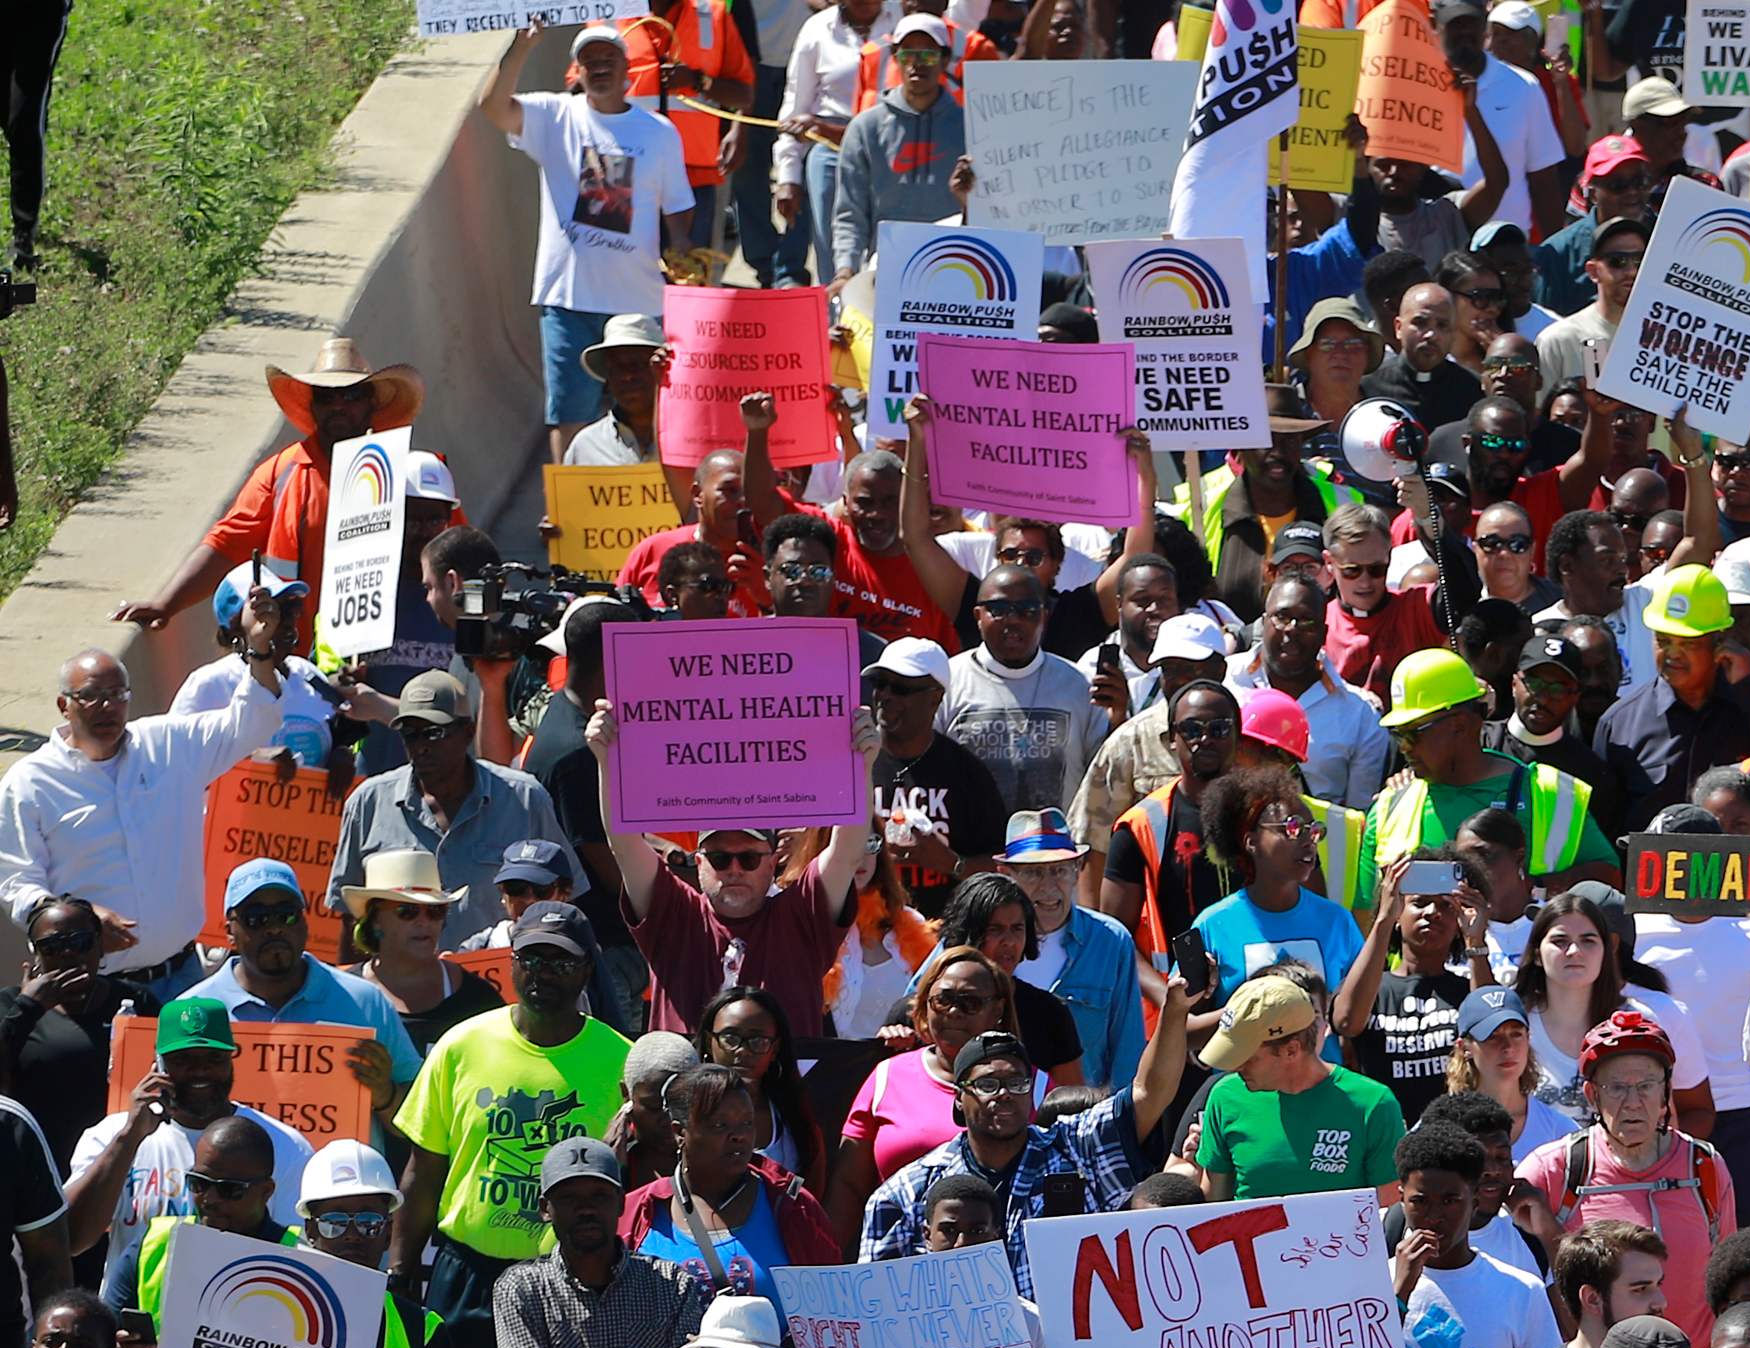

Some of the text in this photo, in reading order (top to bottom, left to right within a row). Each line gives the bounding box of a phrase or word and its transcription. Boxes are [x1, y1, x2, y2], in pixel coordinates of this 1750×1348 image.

[572, 5, 589, 20] TO
[1709, 22, 1741, 39] WE
[696, 320, 766, 338] WE NEED
[909, 315, 1008, 327] COALITION
[1650, 302, 1706, 333] STOP
[1134, 326, 1226, 336] COALITION
[764, 353, 802, 370] FOR
[1161, 352, 1239, 363] THE BORDER
[971, 368, 1077, 395] WE NEED
[1166, 366, 1230, 386] NEED
[1636, 351, 1734, 397] SAVE THE
[1145, 388, 1224, 411] SAFE
[1631, 367, 1730, 414] CHILDREN
[936, 402, 1122, 434] MENTAL HEALTH
[969, 441, 1088, 470] FACILITIES
[589, 486, 631, 507] WE
[336, 570, 383, 595] WE NEED
[332, 591, 382, 628] JOBS
[669, 653, 793, 677] WE NEED
[622, 696, 844, 722] MENTAL HEALTH
[665, 741, 807, 764] FACILITIES
[237, 777, 300, 810] STOP
[657, 793, 817, 807] Faith Community of Saint Sabina
[1386, 1030, 1455, 1053] DESERVE
[253, 1045, 334, 1075] THIS
[1317, 1129, 1351, 1144] TOP
[1313, 1143, 1348, 1158] BOX
[1310, 1162, 1346, 1174] FOODS
[1072, 1204, 1289, 1340] NOT
